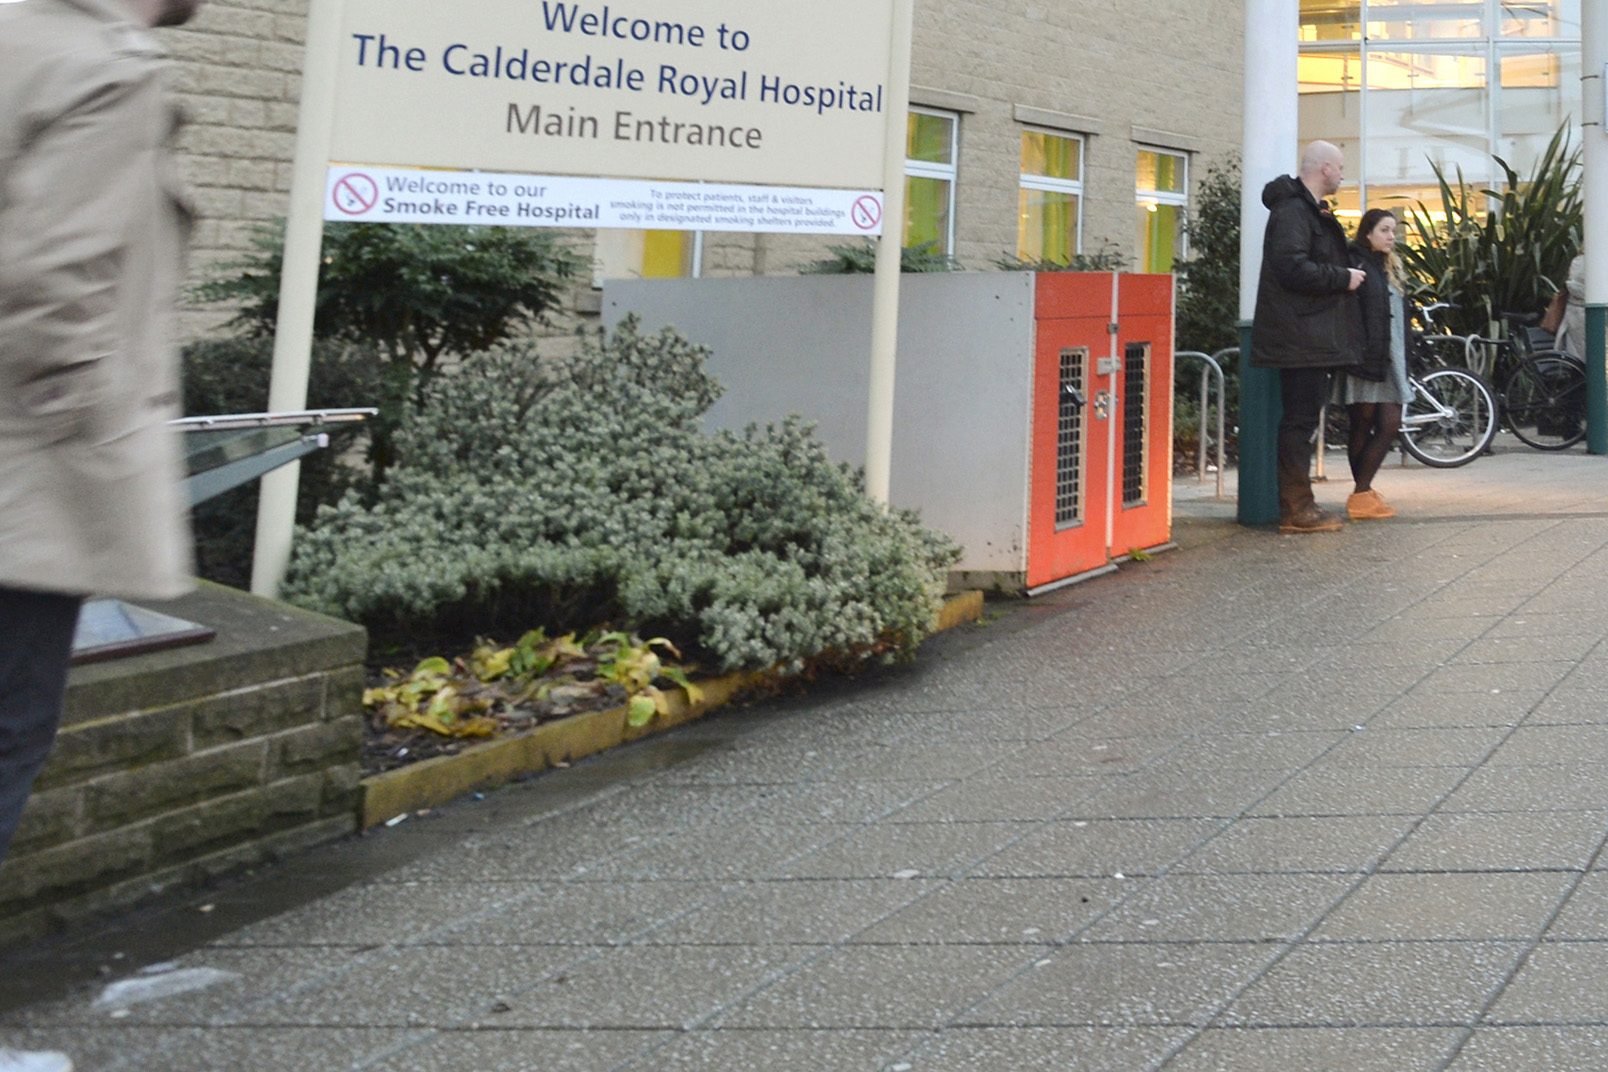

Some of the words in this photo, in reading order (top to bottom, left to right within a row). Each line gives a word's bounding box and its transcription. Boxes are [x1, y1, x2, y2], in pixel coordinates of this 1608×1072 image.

[542, 0, 704, 47] Welcome
[717, 23, 750, 51] to
[352, 33, 427, 72] The
[443, 44, 645, 91] Calderdale
[658, 64, 747, 105] Royal
[760, 75, 883, 115] Hospital
[505, 102, 598, 139] Main
[613, 110, 763, 149] Entrance
[383, 197, 458, 216] Smoke
[465, 200, 510, 217] Free
[517, 202, 600, 222] Hospital
[386, 175, 481, 196] Welcome
[488, 180, 507, 197] to
[514, 184, 547, 198] our
